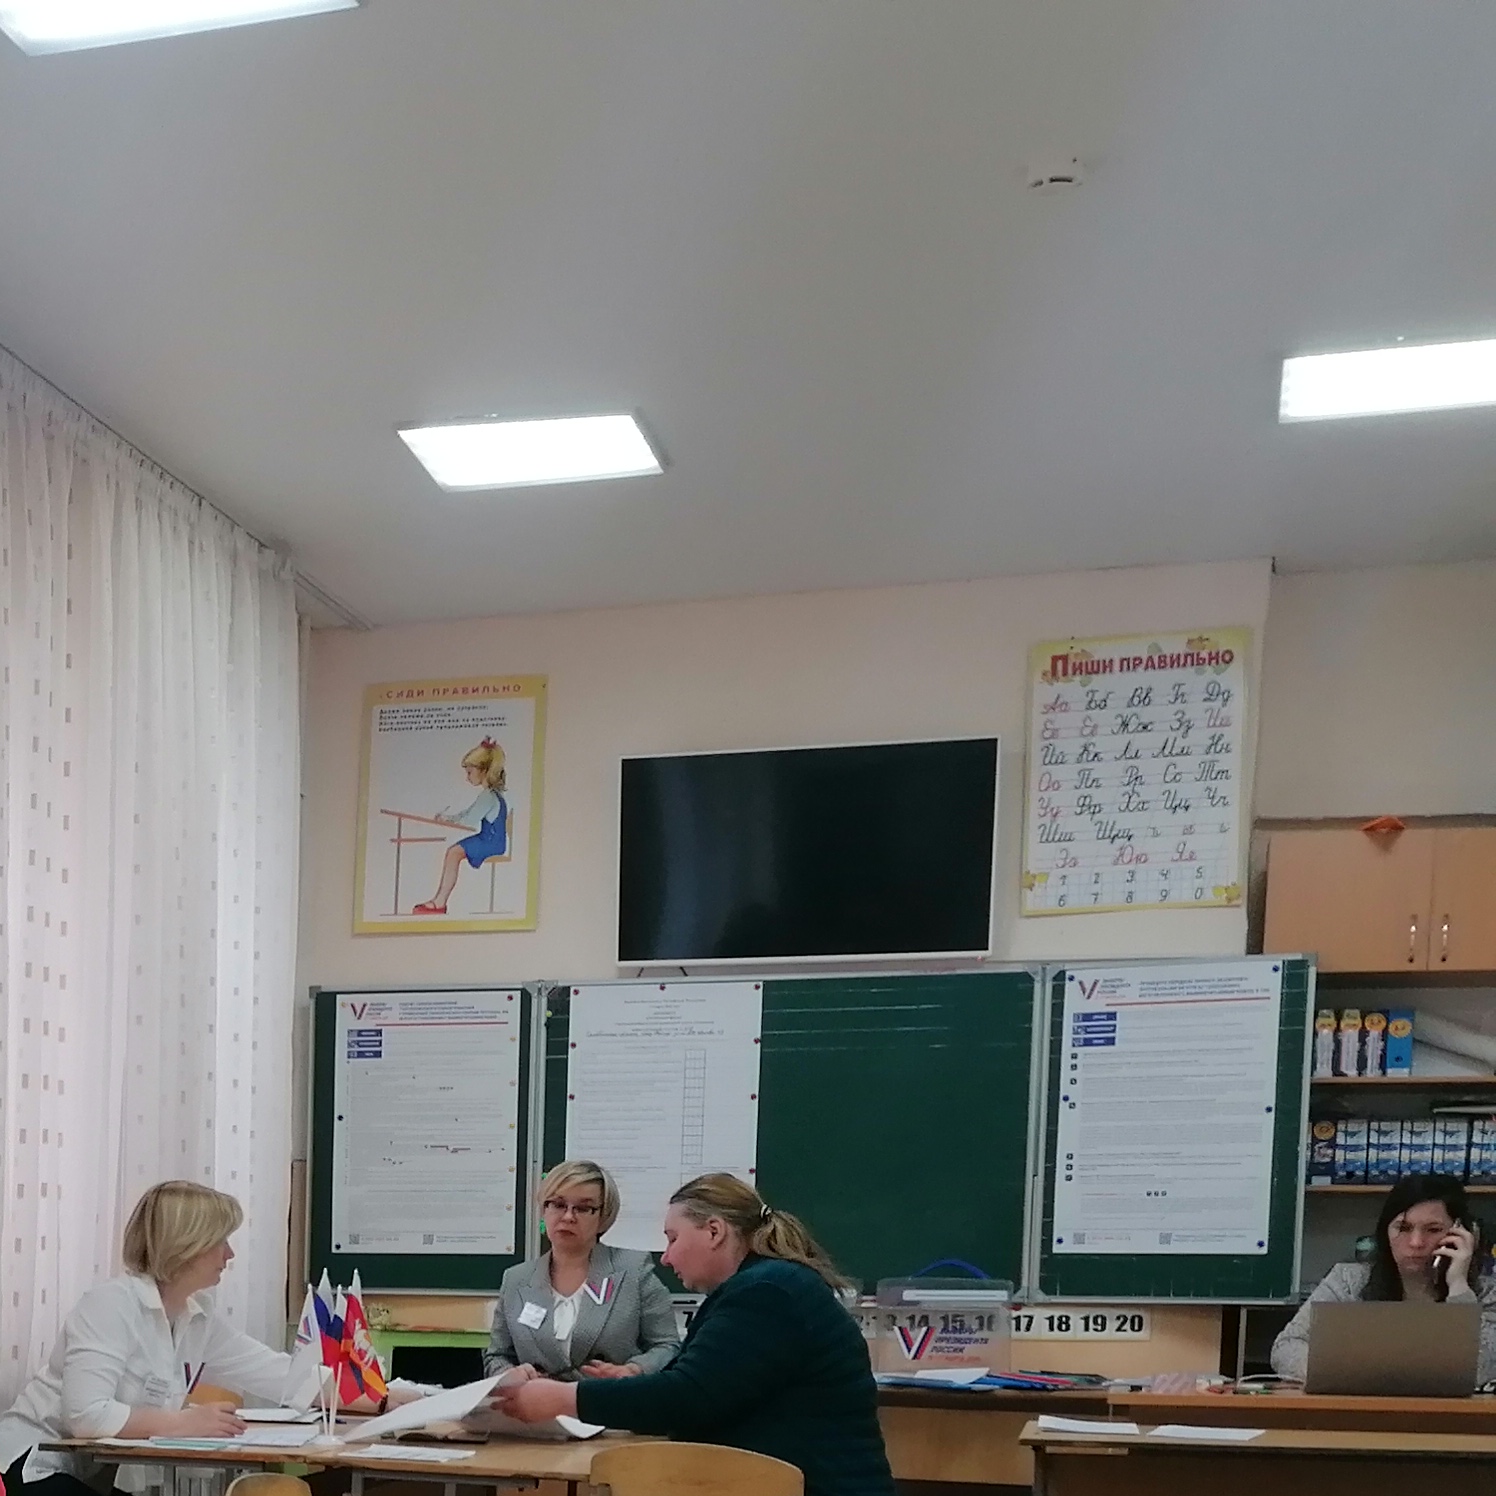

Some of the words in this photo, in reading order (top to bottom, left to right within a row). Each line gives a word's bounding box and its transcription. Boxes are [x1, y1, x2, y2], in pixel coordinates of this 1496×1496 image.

[386, 688, 425, 699] СИДИ
[432, 683, 522, 697] ПРАВИЛЬНО
[1059, 874, 1067, 886] 1
[1093, 873, 1101, 885] 2
[1126, 870, 1136, 883] 3
[1159, 868, 1171, 881] 4
[1195, 866, 1204, 879] 5
[1058, 894, 1066, 908] 6
[1091, 892, 1102, 905] 7
[1125, 890, 1134, 904] 8
[1159, 889, 1170, 903] 9
[1194, 887, 1203, 900] 0
[1012, 1314, 1034, 1332] 17
[1044, 1314, 1071, 1332] 18
[1080, 1314, 1107, 1332] 19
[1115, 1314, 1144, 1332] 20
